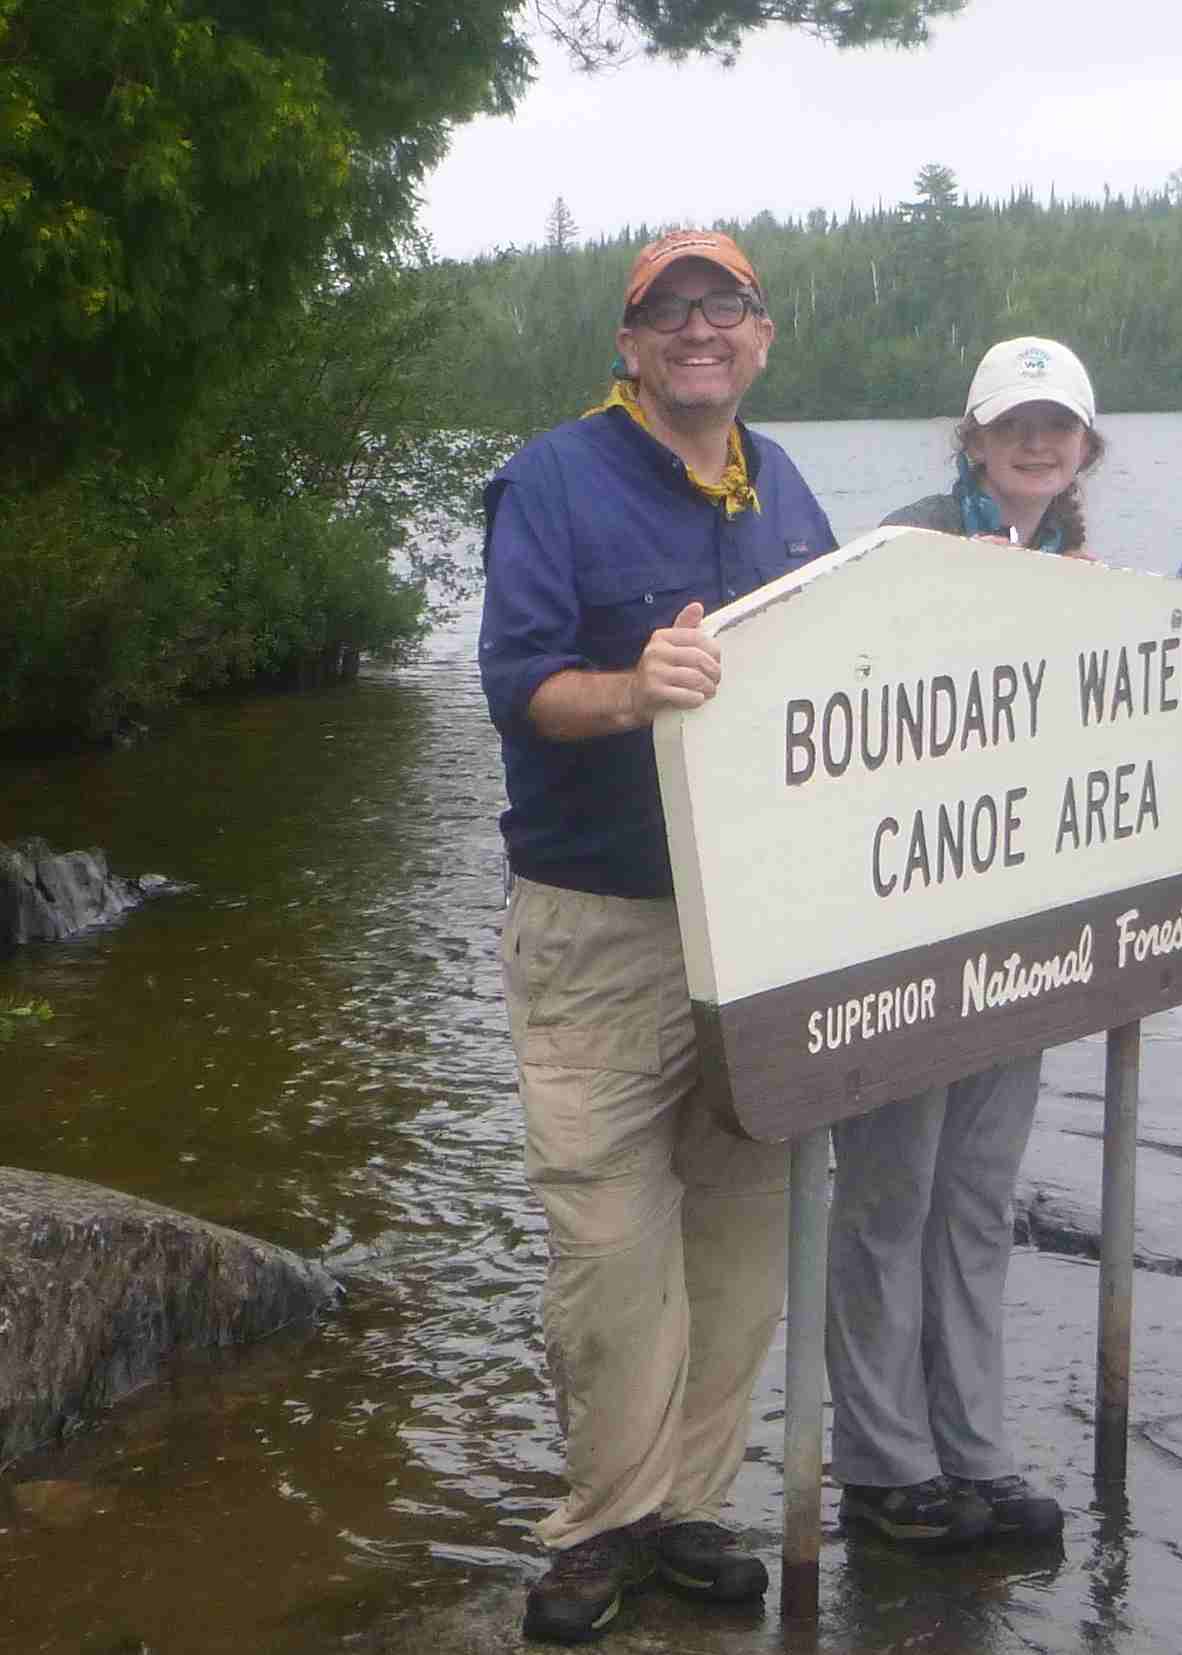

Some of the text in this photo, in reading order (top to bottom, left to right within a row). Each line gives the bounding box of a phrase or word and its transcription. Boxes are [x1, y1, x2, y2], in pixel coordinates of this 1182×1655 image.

[785, 659, 1047, 786] BOUNDARY
[872, 760, 1160, 898] CANOE AREA
[808, 976, 937, 1055] SUPERIOR
[961, 925, 1094, 1017] National
